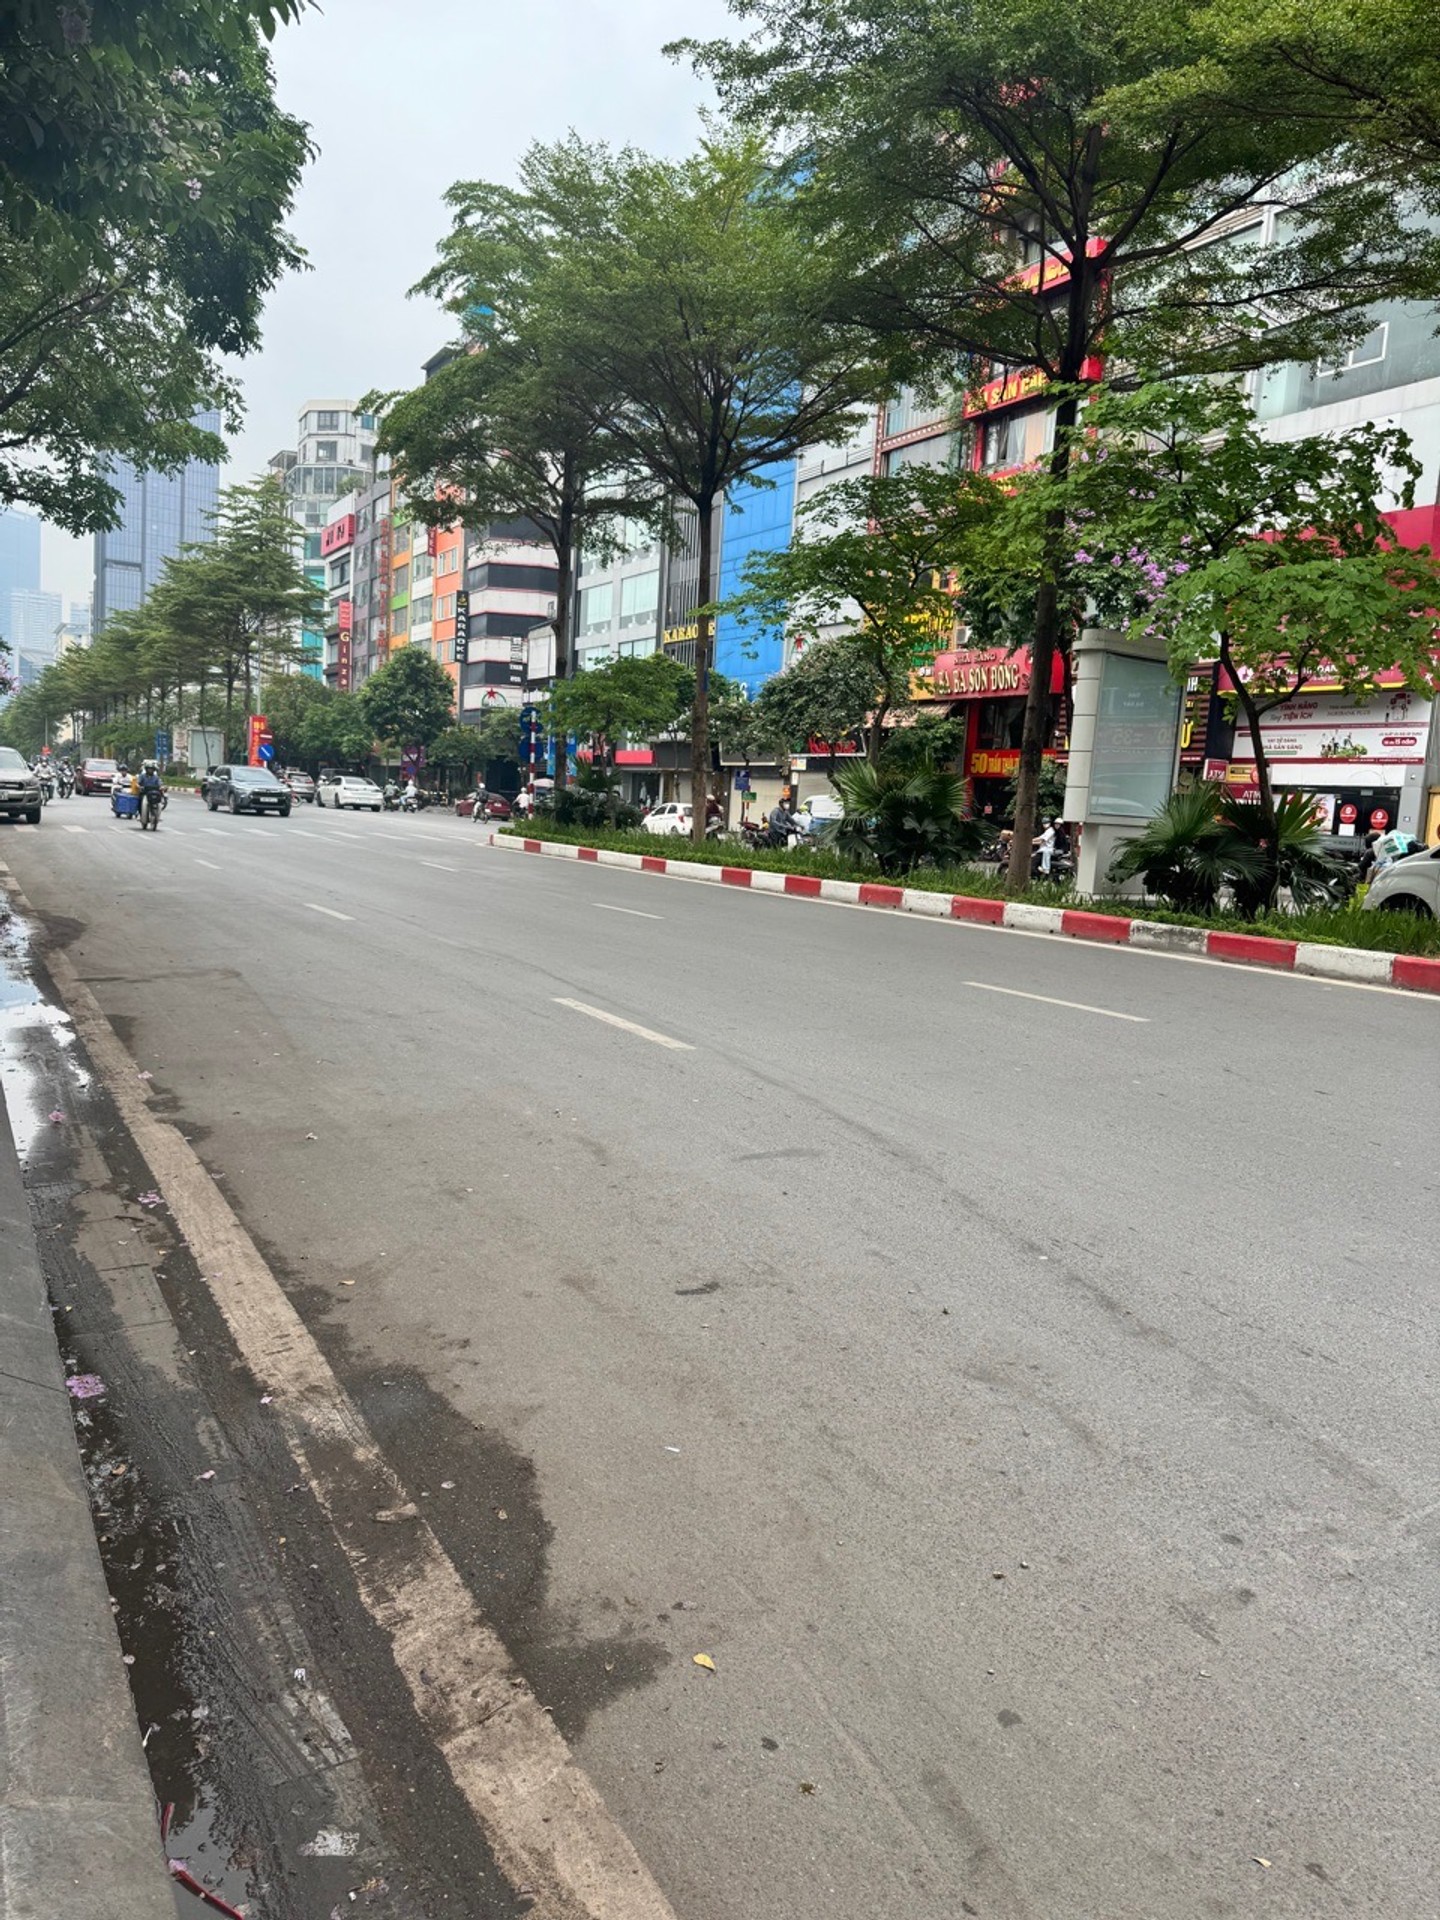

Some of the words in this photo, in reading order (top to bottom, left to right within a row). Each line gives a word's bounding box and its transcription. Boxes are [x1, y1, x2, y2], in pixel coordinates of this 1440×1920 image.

[456, 607, 467, 661] KARAOKE
[663, 622, 715, 643] KARAOE
[340, 631, 350, 686] Ginza
[971, 753, 988, 774] 50
[1242, 790, 1261, 798] ATM
